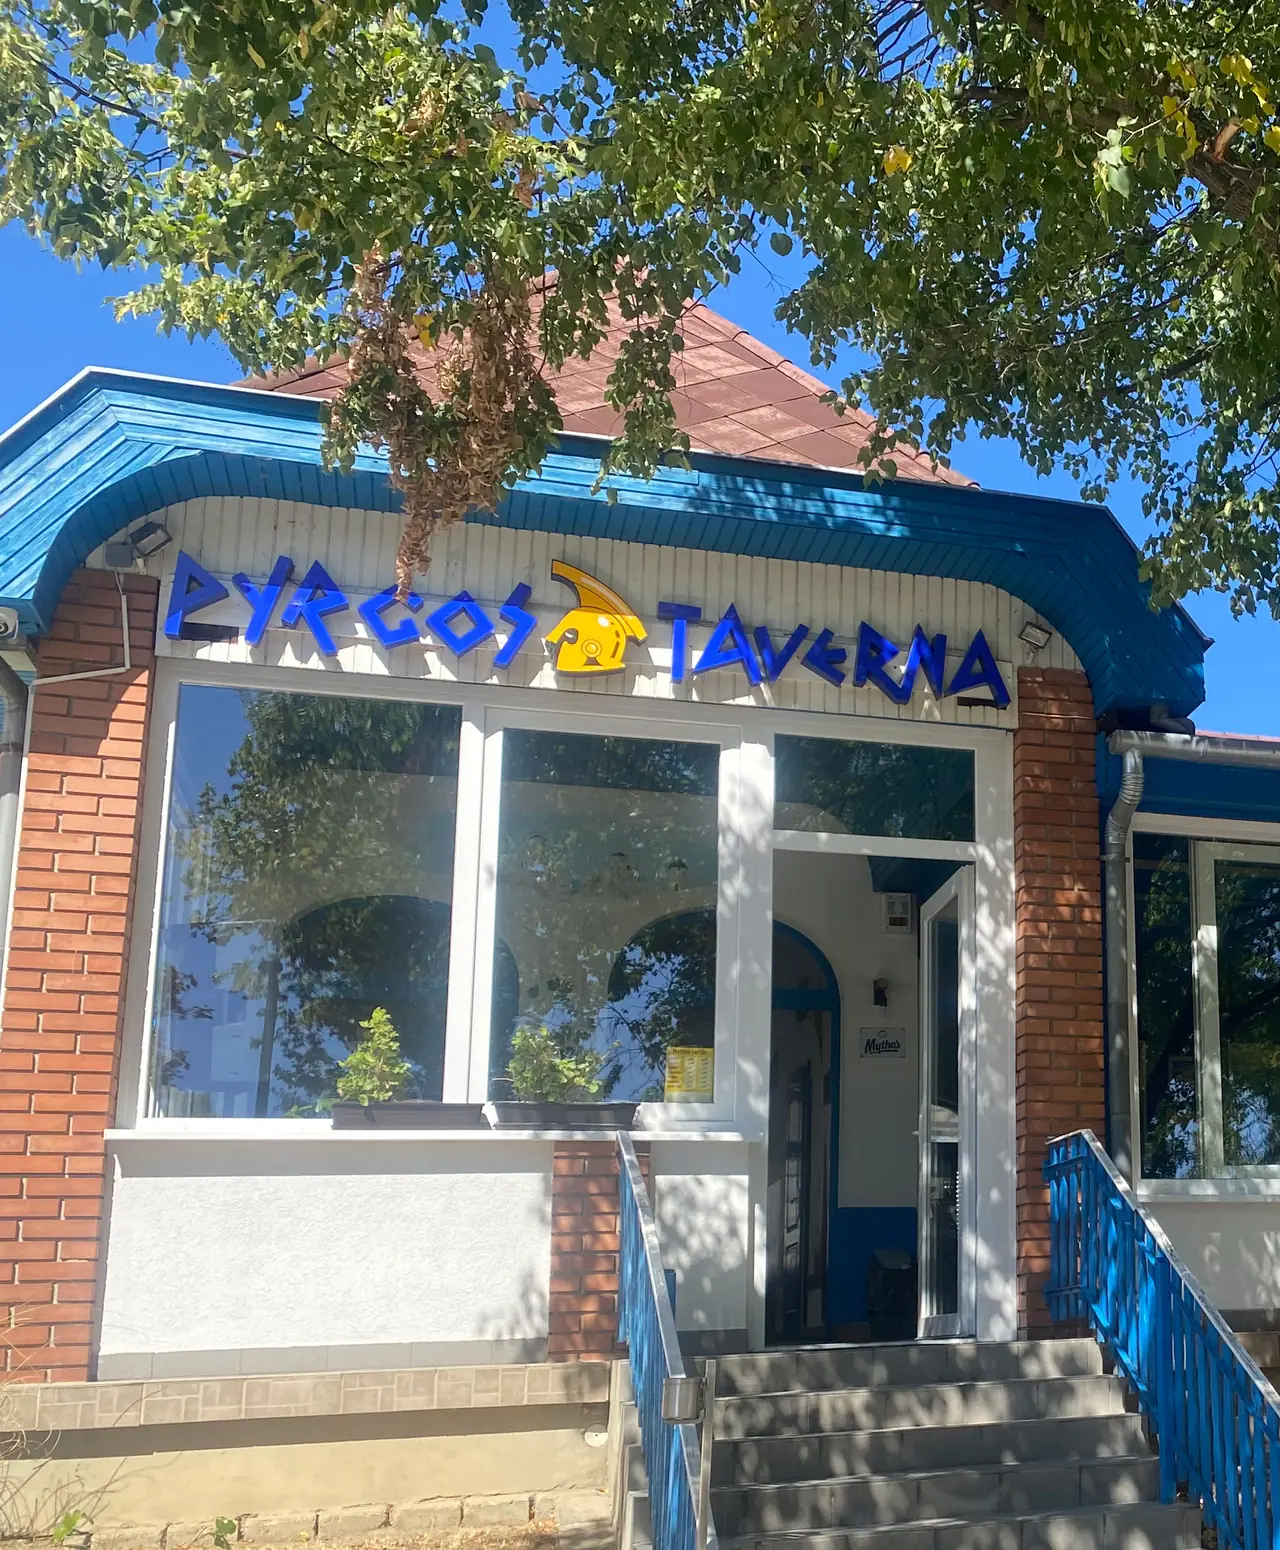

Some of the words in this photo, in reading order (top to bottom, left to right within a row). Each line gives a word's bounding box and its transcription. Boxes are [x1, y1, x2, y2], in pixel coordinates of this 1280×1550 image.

[165, 549, 538, 670] PYRGOS
[656, 602, 1012, 709] TAVERNA
[864, 1037, 901, 1055] Mythos
